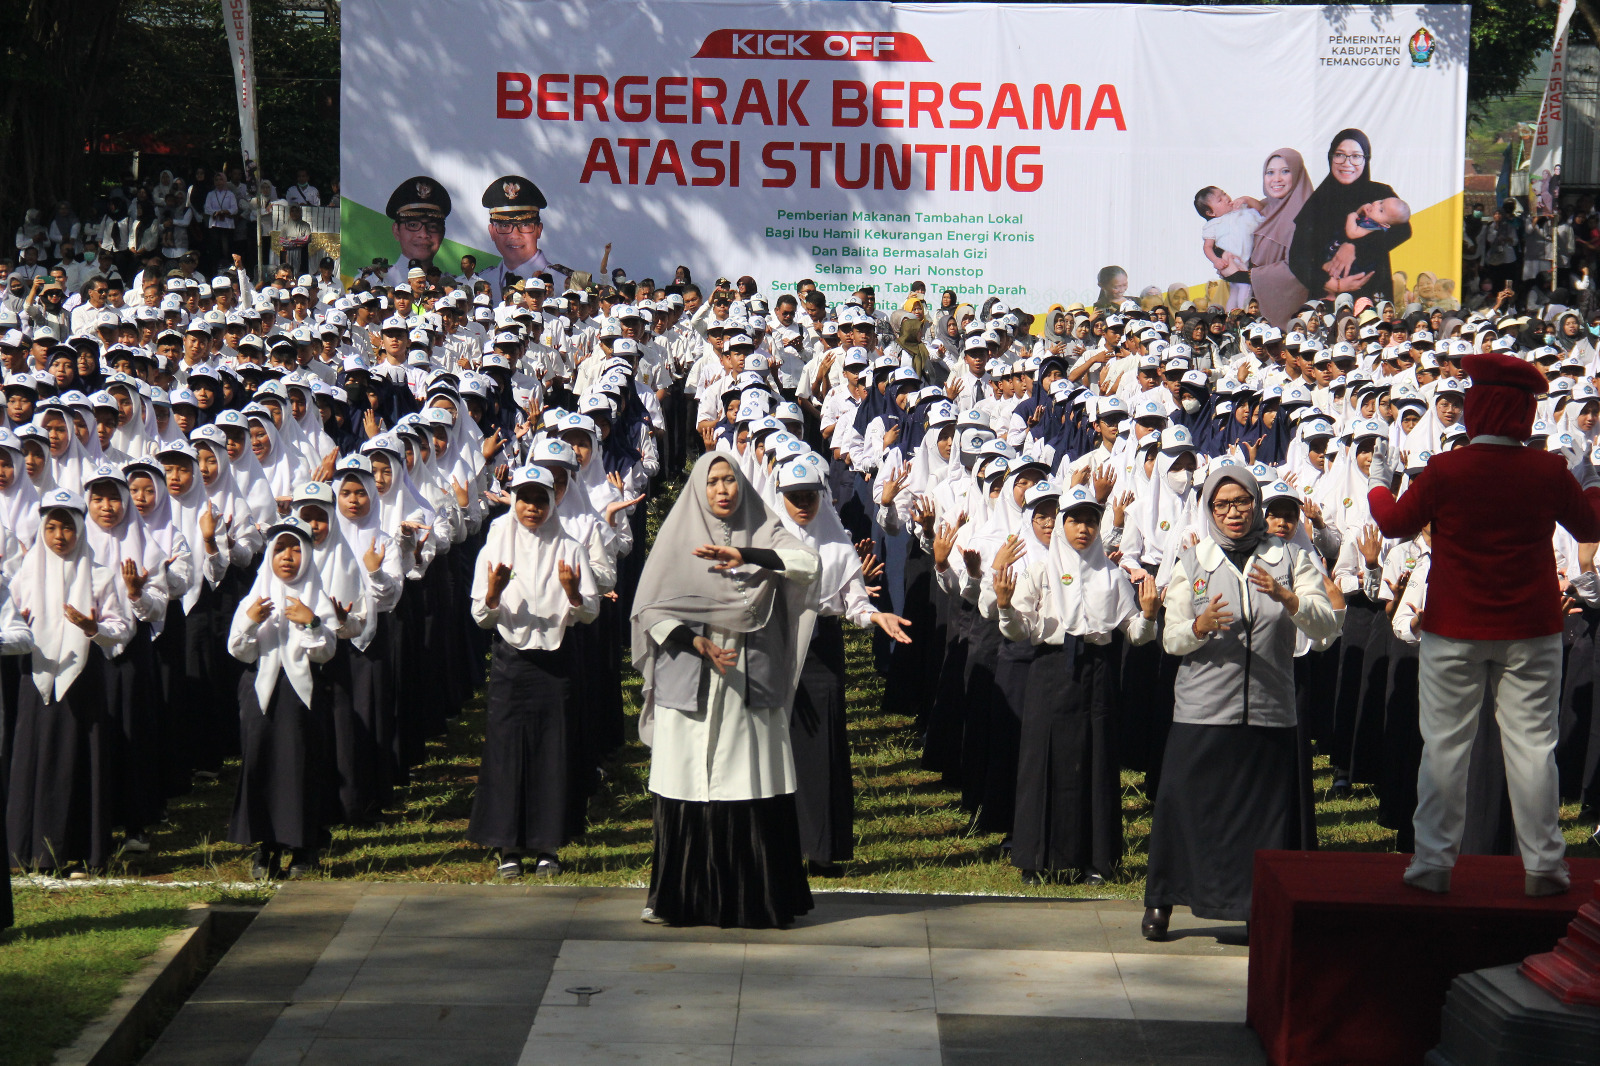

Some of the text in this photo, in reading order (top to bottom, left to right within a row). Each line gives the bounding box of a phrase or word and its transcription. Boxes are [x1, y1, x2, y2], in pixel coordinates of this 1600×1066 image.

[732, 33, 895, 57] KICK OFF
[1329, 35, 1401, 44] PEMERINTAH
[1332, 46, 1400, 55] KABUPATEN
[1319, 57, 1400, 66] TEMANGGUNG
[496, 71, 1127, 131] BERGERAK BERSAMA
[1549, 78, 1562, 121] ATASI
[579, 136, 1044, 193] ATASI STUNTING
[777, 209, 1023, 224] Pemberian Makanan Tambahan Lokal
[765, 226, 1035, 243] Bagi Ibu Hamil Kekurangan Energi Kronis
[812, 245, 988, 259] Dan Balita Bermasalah Gizi
[815, 263, 984, 278] Selama 90 Hari Nonstop
[771, 280, 798, 291] Sert
[885, 282, 913, 293] Tabl
[930, 283, 984, 294] Tambah
[987, 284, 1027, 295] Darah
[873, 300, 898, 310] nita
